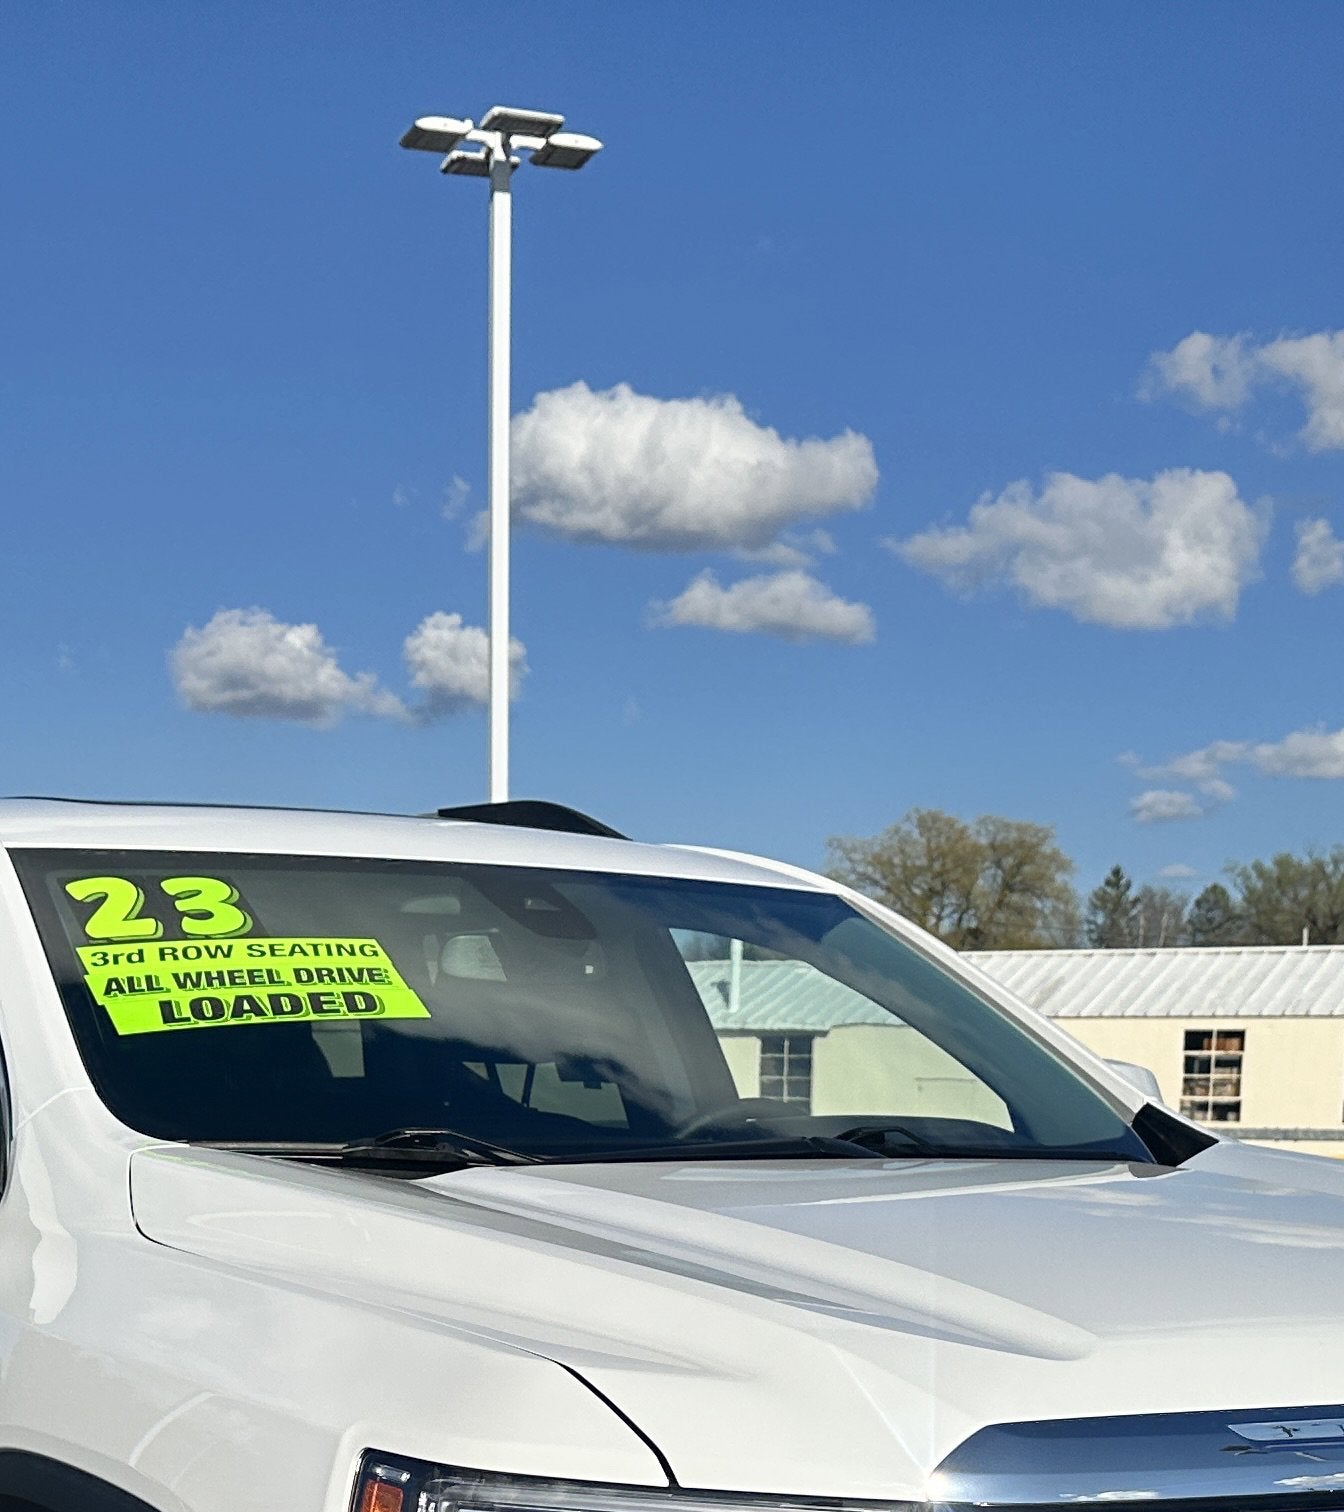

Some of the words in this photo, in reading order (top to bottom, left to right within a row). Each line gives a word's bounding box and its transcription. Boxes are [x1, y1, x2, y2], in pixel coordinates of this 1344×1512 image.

[65, 877, 254, 943] 23
[90, 949, 145, 968] 3rd
[158, 944, 233, 963] ROW
[246, 942, 380, 960] SEATING
[102, 973, 170, 998] ALL
[172, 970, 289, 991] WHEEL
[294, 967, 393, 987] DRIVE
[160, 990, 386, 1026] LOADED
